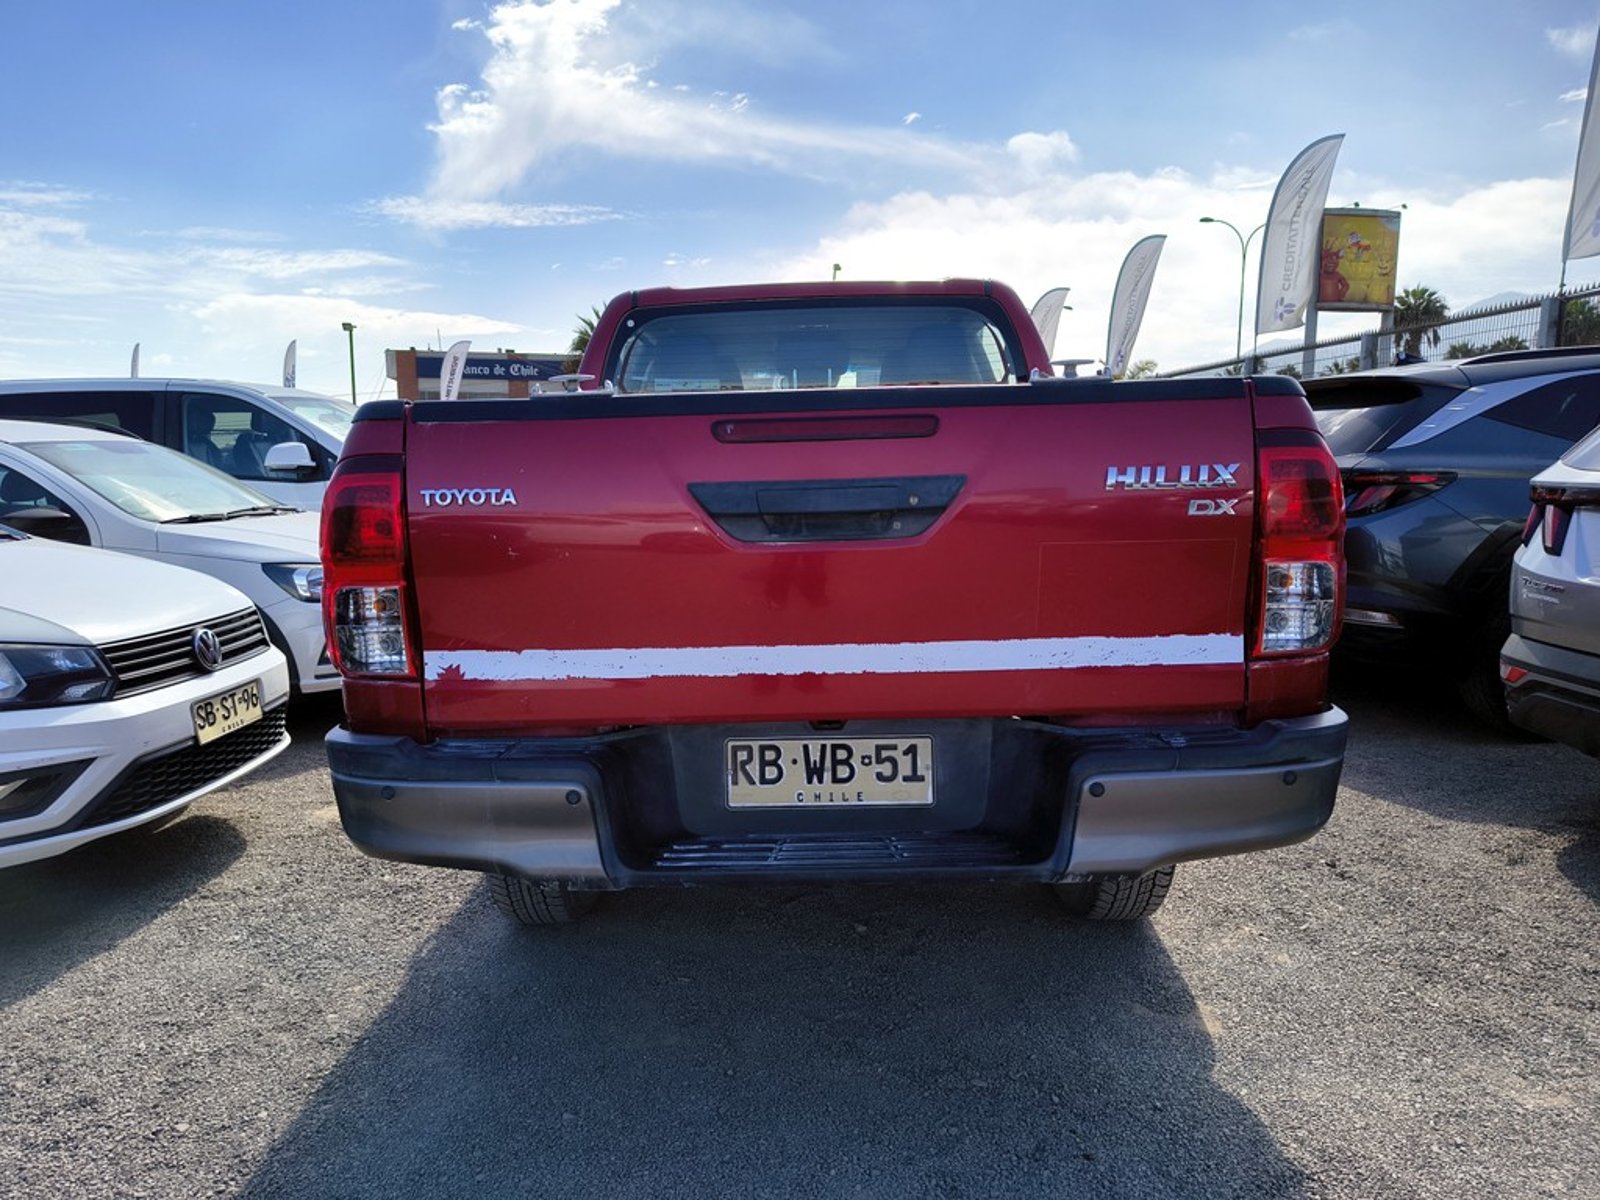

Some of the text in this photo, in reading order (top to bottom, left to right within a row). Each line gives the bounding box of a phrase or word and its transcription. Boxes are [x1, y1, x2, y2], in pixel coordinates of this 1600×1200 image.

[463, 363, 540, 377] anco de Chile
[1105, 462, 1240, 491] HILUX
[420, 488, 518, 507] TOYOTA
[1187, 499, 1239, 516] DX
[796, 791, 864, 803] CHILE
